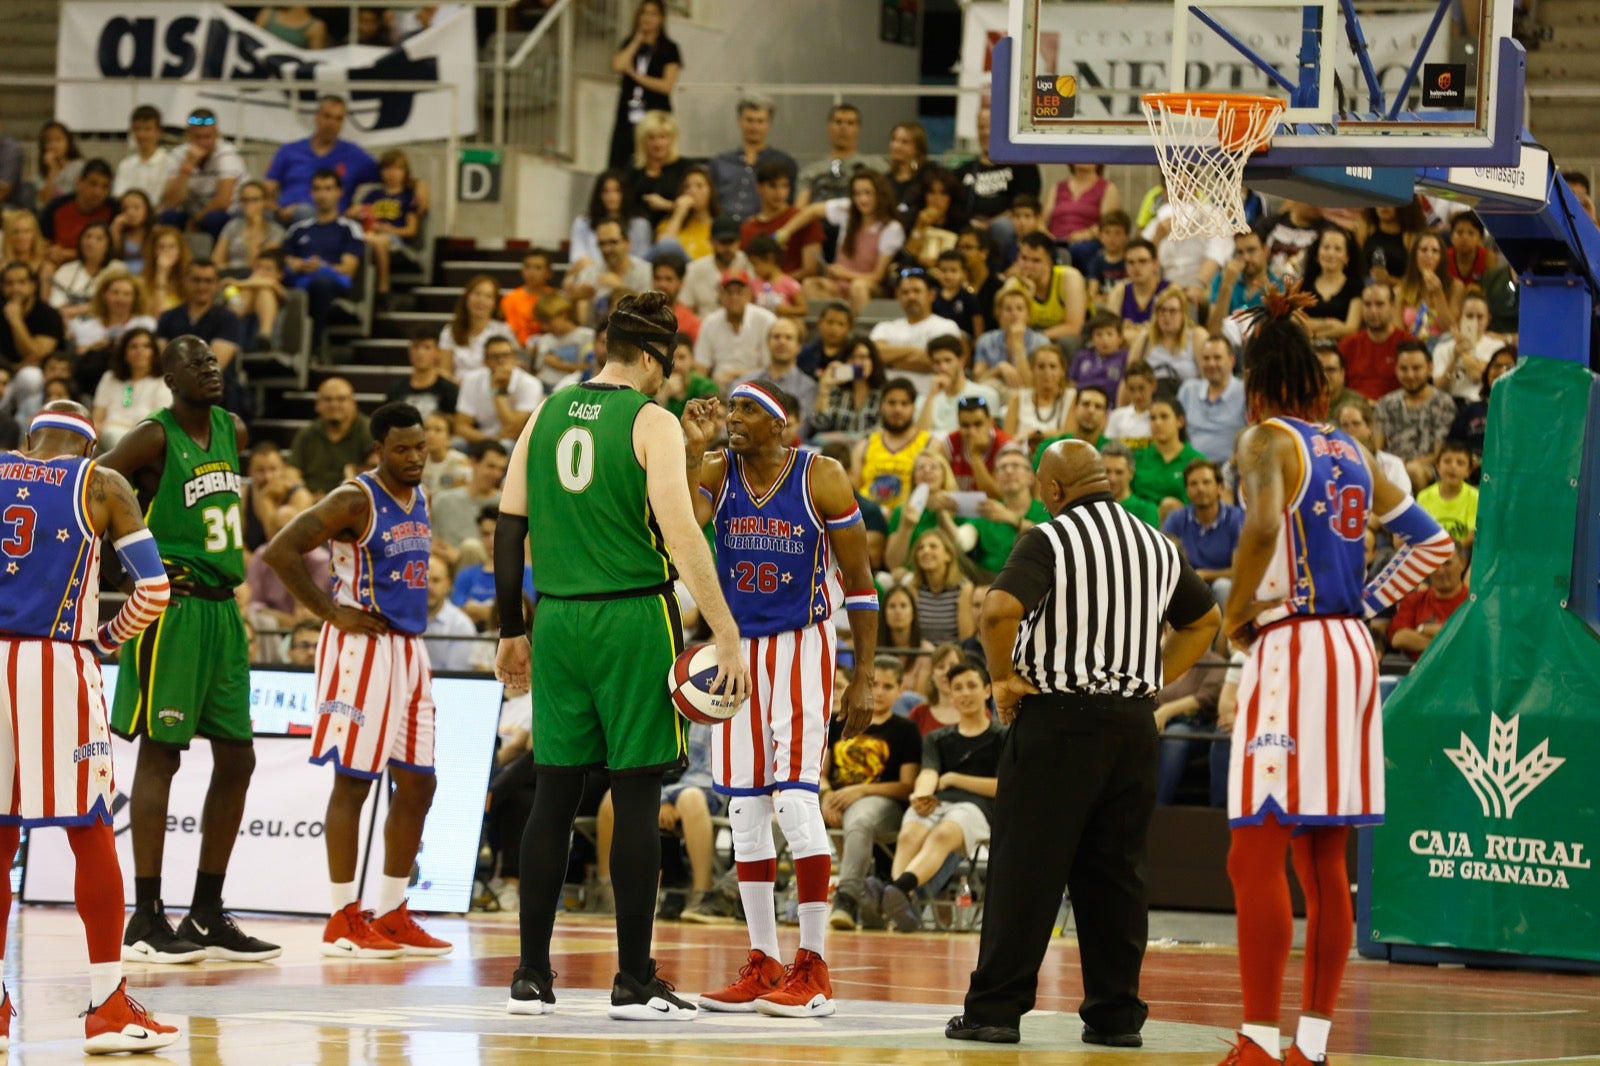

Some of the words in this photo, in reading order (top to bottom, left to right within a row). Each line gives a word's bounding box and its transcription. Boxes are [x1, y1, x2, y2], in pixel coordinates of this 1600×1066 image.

[1036, 80, 1053, 91] Liga
[1036, 95, 1060, 107] LEB
[1035, 106, 1059, 116] ORO
[461, 163, 493, 199] D
[568, 400, 602, 421] CAGER
[555, 425, 595, 494] 0
[1, 504, 38, 559] 3
[202, 502, 244, 554] 31
[729, 516, 791, 539] HARLEM
[724, 534, 805, 554] OBETROTTERS
[402, 559, 428, 590] 42
[735, 560, 779, 594] 26
[1409, 830, 1474, 858] CAJA
[1484, 833, 1591, 869] RURAL
[1428, 858, 1456, 879] DE
[1459, 860, 1570, 889] GRANADA
